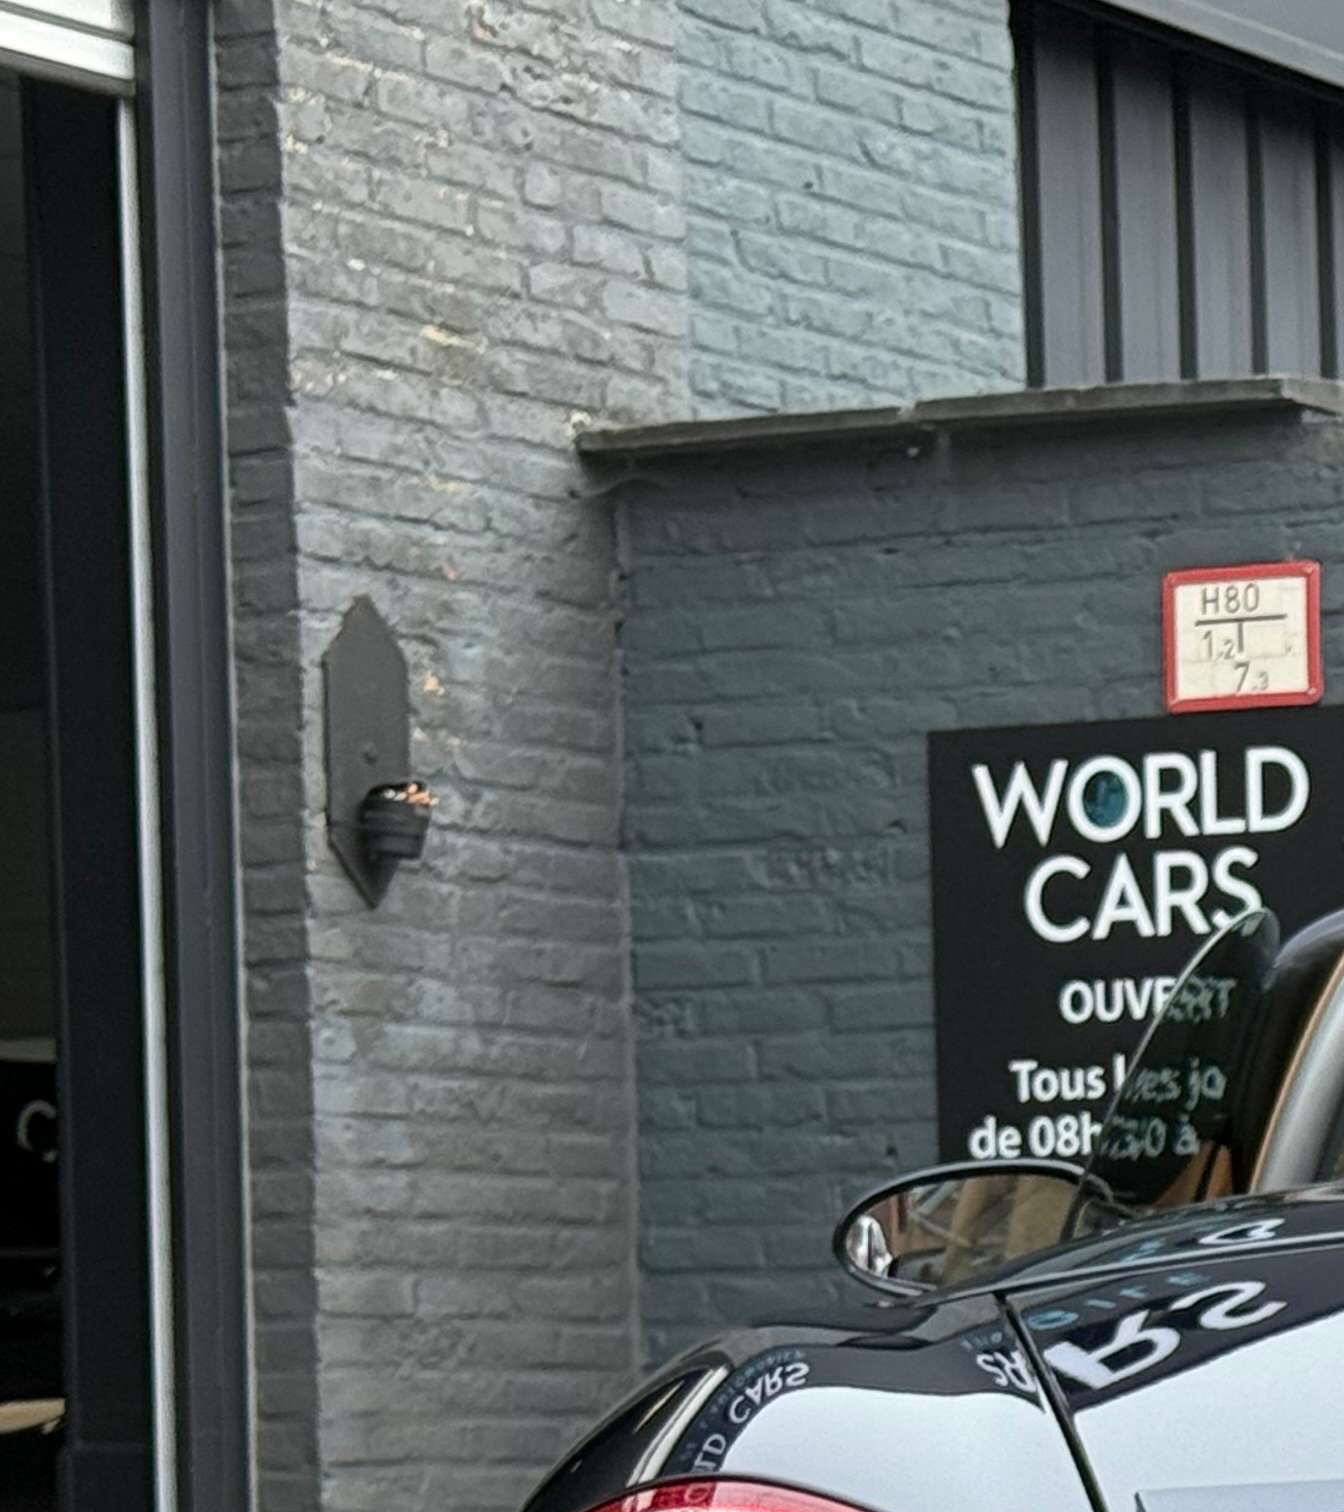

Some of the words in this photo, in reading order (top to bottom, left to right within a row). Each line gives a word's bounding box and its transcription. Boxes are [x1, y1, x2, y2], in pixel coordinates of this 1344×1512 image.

[1202, 583, 1261, 615] H80
[971, 745, 1310, 849] WORLD
[1024, 845, 1263, 943] CARS
[1008, 1059, 1106, 1103] Tous
[968, 1114, 1022, 1160] de
